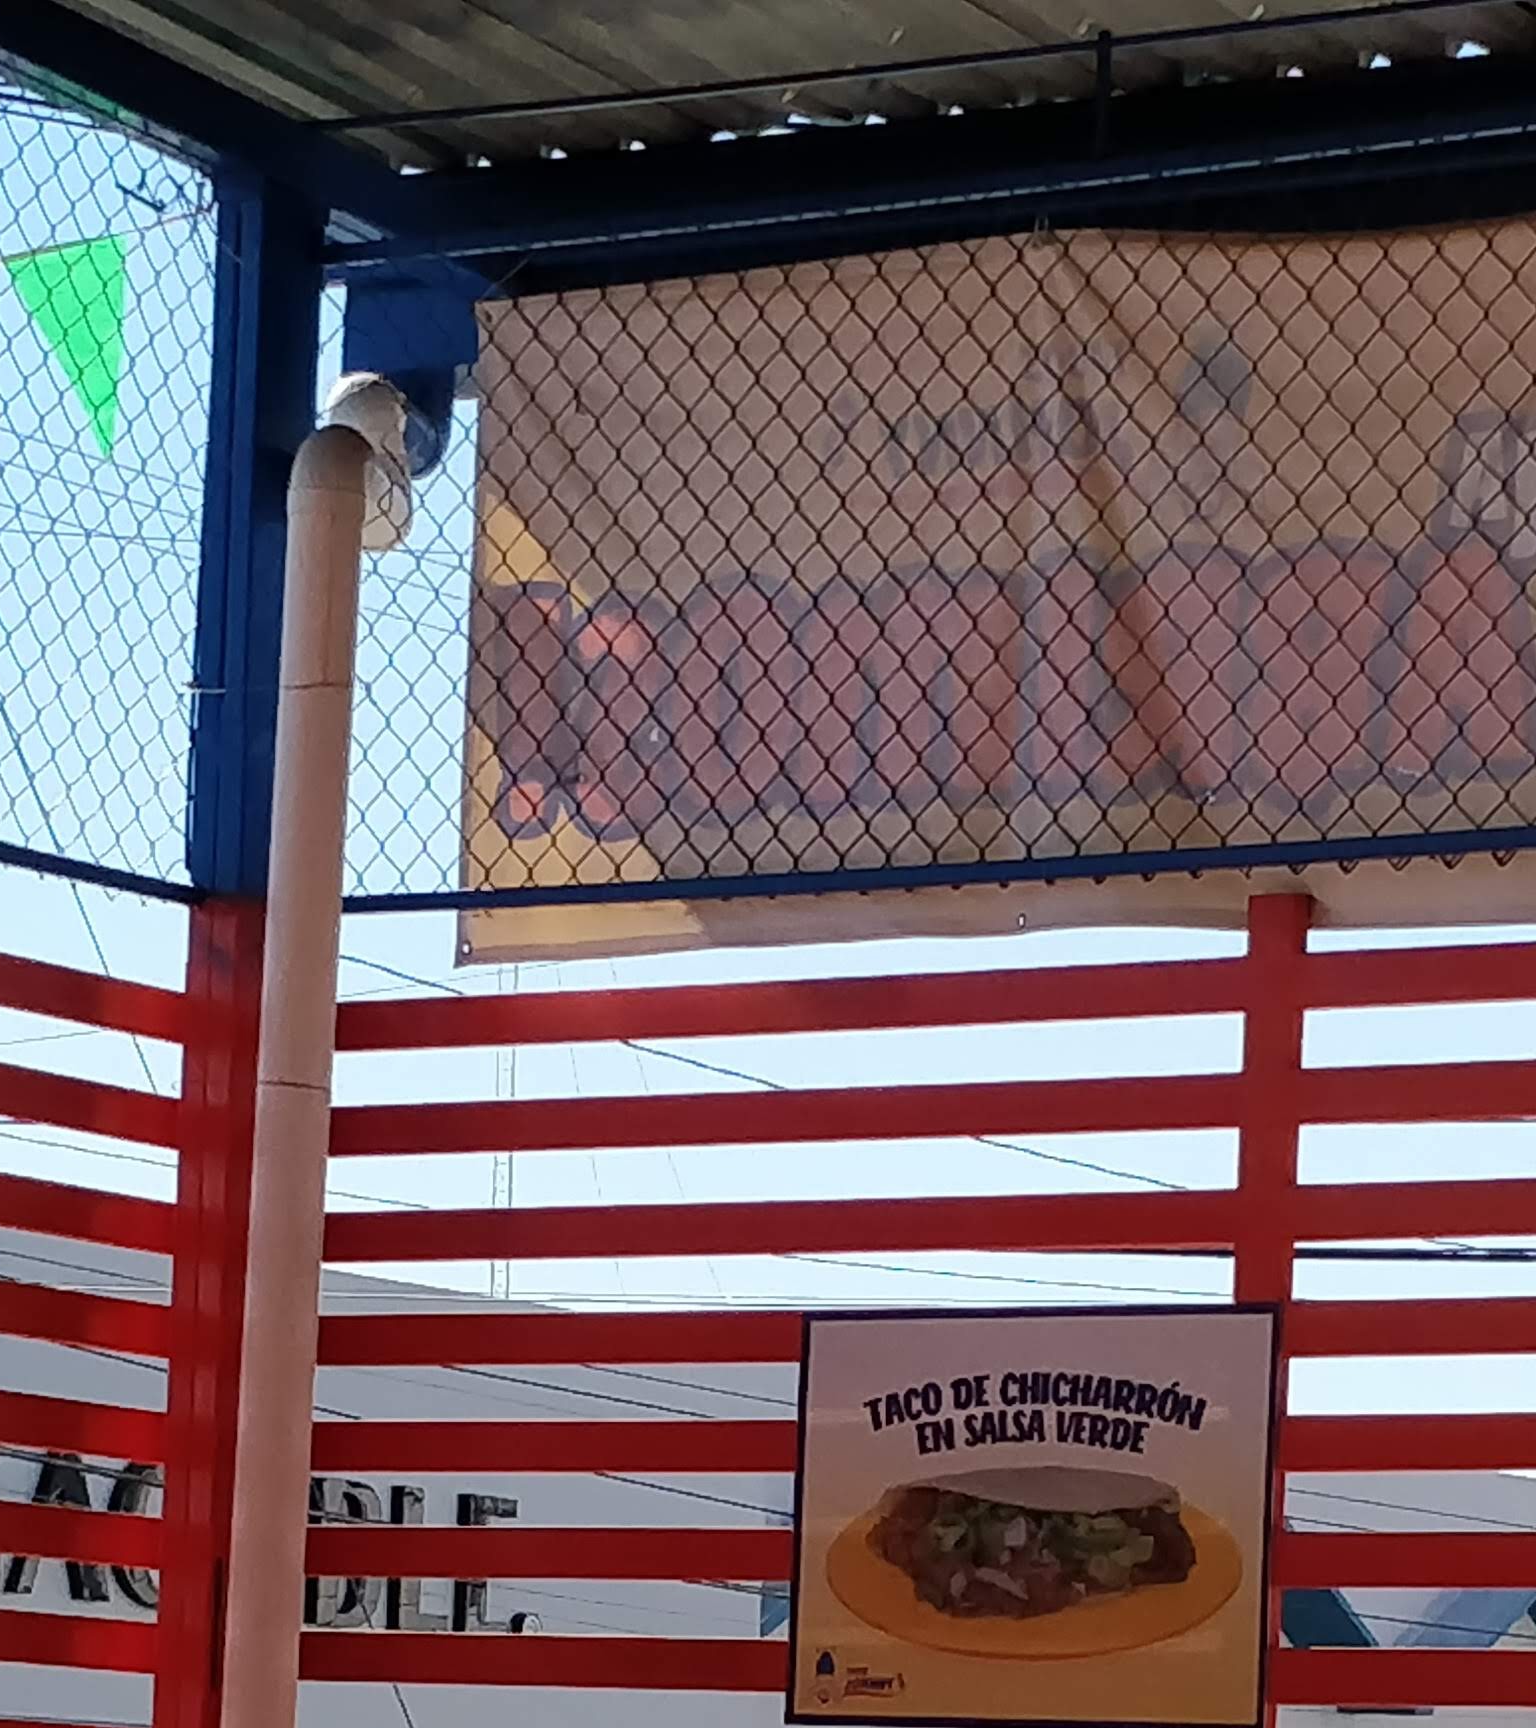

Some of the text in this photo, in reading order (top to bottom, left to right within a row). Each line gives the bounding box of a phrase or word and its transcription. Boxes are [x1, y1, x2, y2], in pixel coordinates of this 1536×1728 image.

[864, 1371, 1207, 1432] TACO DE CHICHARRÓN
[915, 1409, 1151, 1455] EN SALSA VERDE
